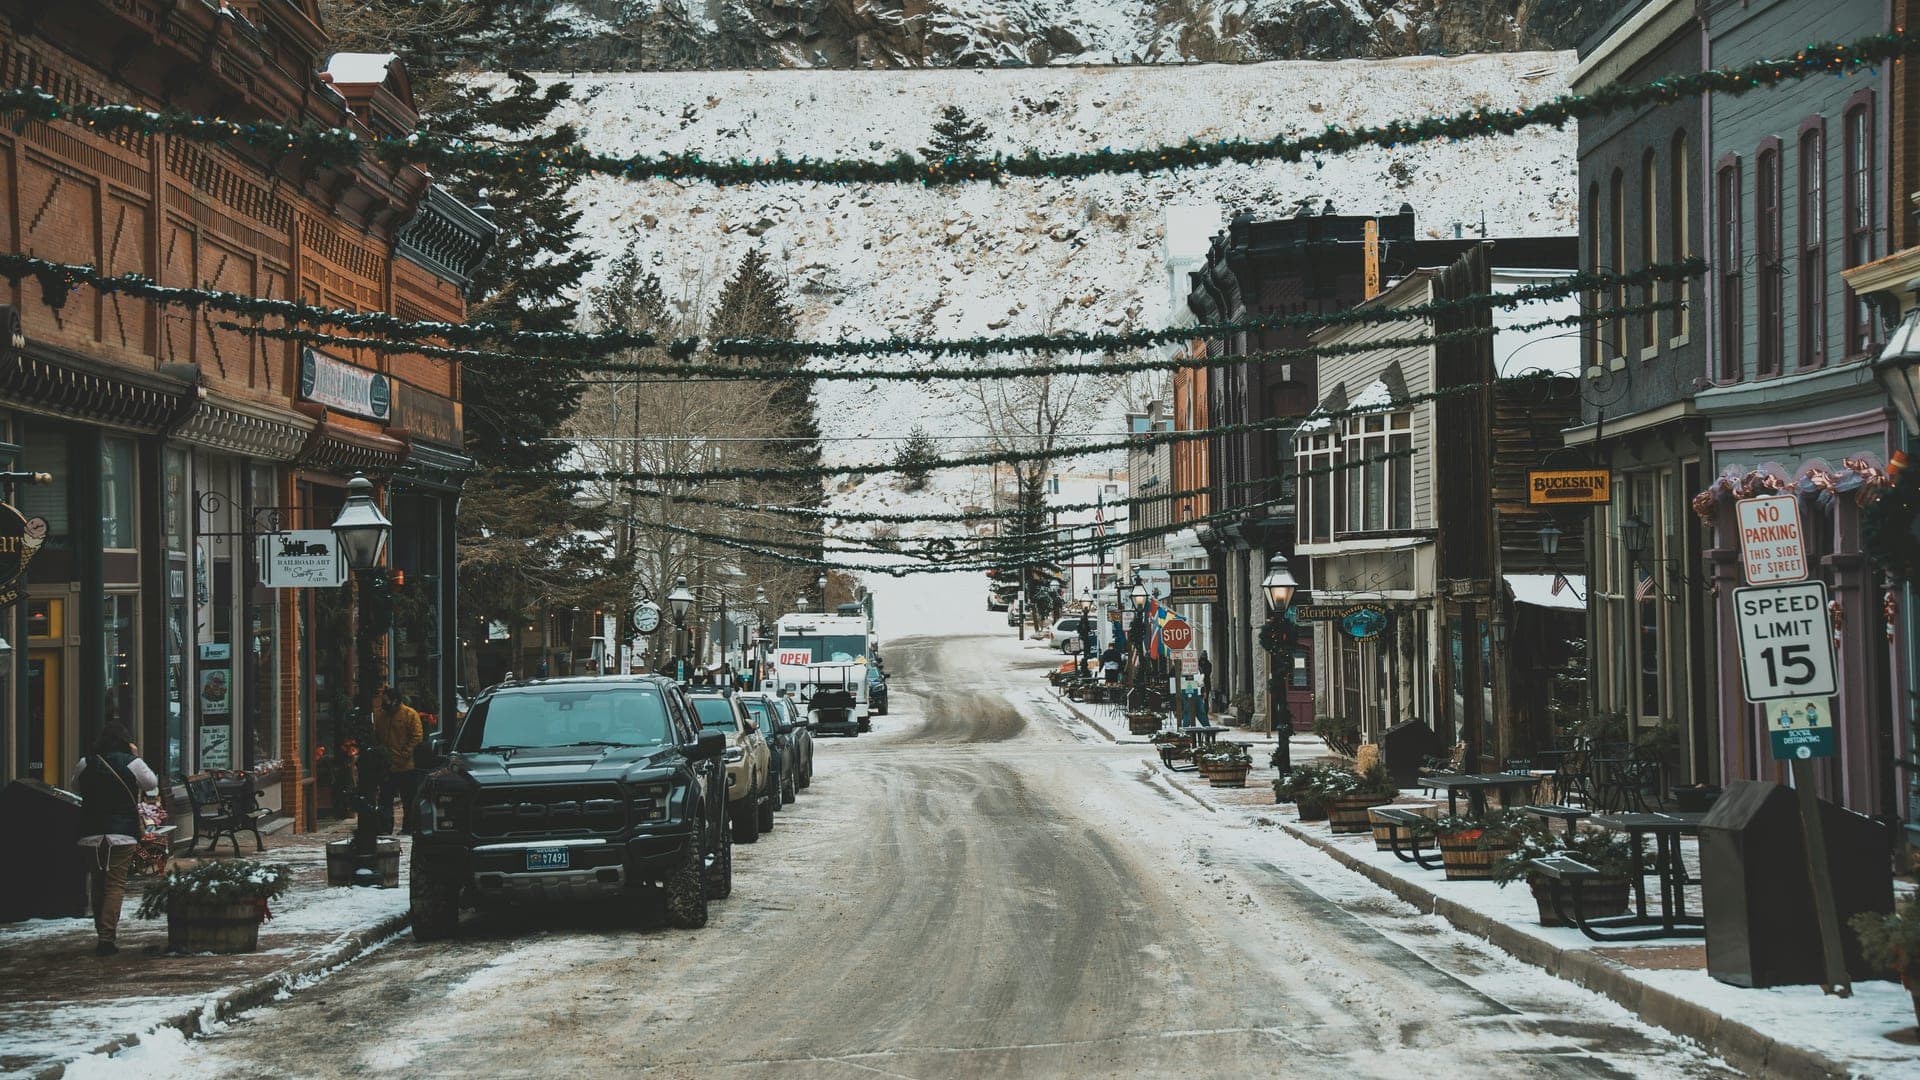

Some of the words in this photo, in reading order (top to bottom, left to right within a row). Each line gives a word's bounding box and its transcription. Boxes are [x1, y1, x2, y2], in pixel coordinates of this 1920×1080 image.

[1534, 475, 1605, 491] BUCKSKIN
[1756, 506, 1779, 522] NO
[1745, 523, 1797, 544] PARKING
[1749, 548, 1771, 560] THIS
[1776, 545, 1799, 557] SIDE
[1750, 563, 1762, 575] OF
[1767, 559, 1801, 573] STREET
[1744, 595, 1820, 616] SPEED
[1163, 628, 1190, 642] STOP
[1755, 619, 1813, 640] LIMIT
[780, 652, 809, 665] OPEN
[1760, 643, 1816, 688] 15
[547, 853, 566, 863] 7491
